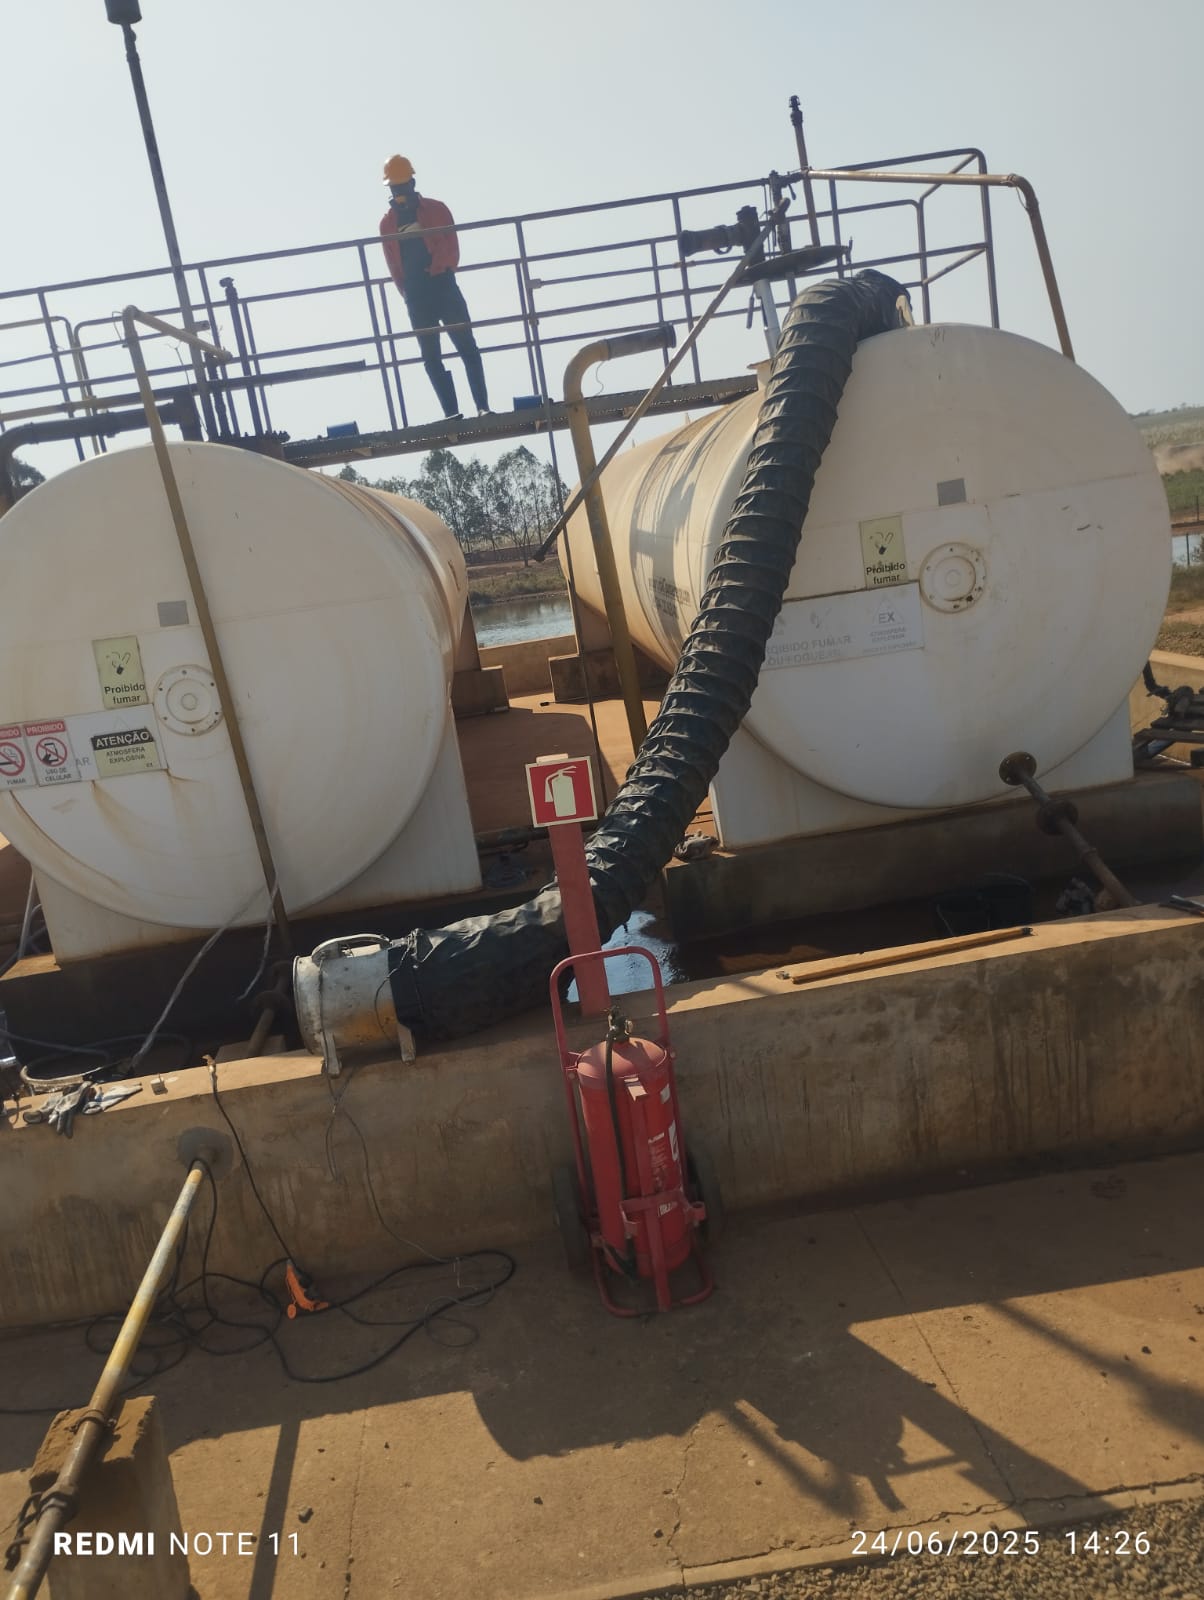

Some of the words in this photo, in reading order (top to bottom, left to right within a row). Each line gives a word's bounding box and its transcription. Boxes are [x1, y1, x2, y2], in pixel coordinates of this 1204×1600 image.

[866, 562, 905, 575] Proibido
[873, 574, 900, 585] fumar
[878, 611, 895, 624] EX
[104, 683, 145, 695] Proibido
[112, 694, 141, 705] fumar
[26, 722, 64, 735] PROIBIDO
[95, 730, 150, 748] ATENÇÃO
[106, 745, 146, 757] ATMOSFERA
[109, 754, 146, 764] EXPLOSIVA
[45, 773, 72, 782] CELULAR
